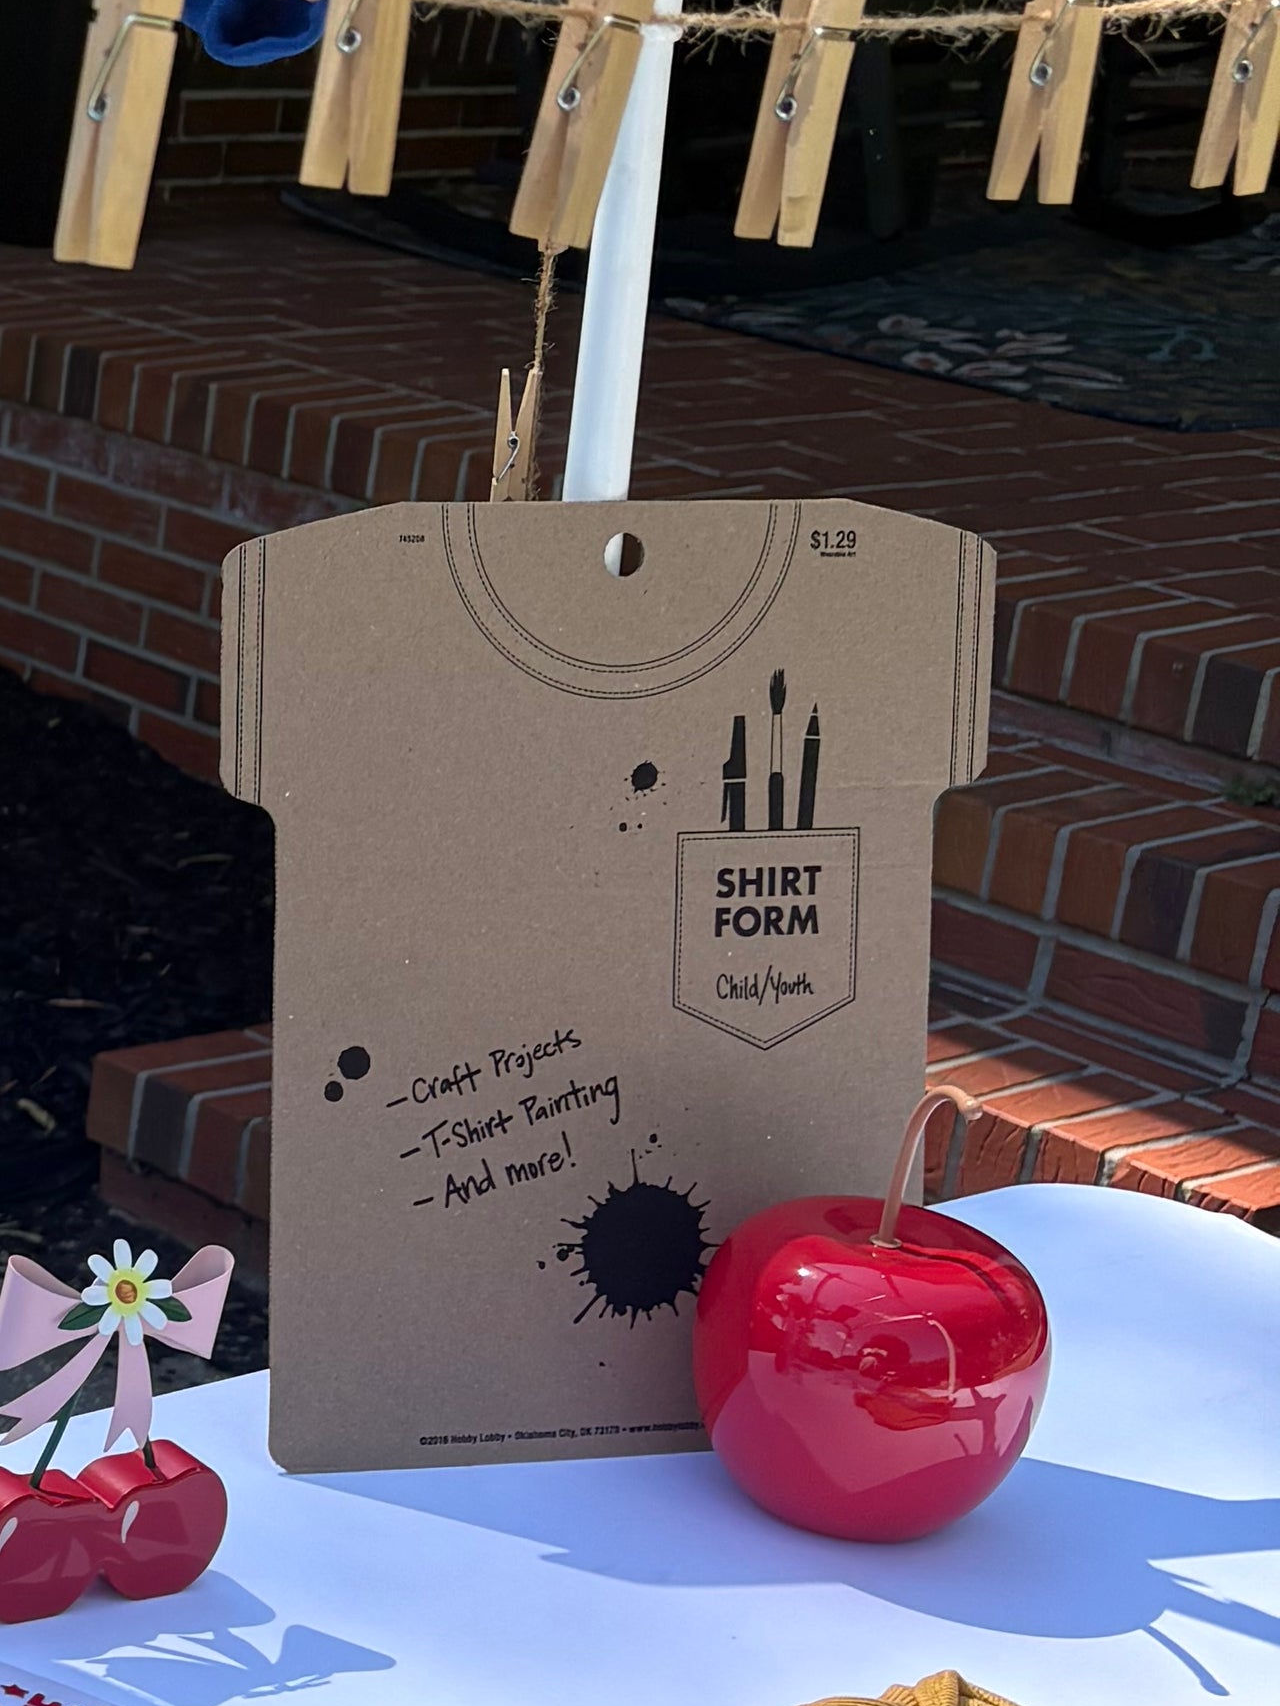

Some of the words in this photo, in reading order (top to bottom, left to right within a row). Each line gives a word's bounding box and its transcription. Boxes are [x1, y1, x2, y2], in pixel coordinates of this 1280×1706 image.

[810, 529, 857, 550] $1.29
[715, 865, 822, 899] SHIRT
[714, 904, 820, 938] FORM
[716, 964, 815, 1006] Child/Youth
[488, 1029, 582, 1079] Projects
[518, 1075, 621, 1126] Painting
[505, 1130, 577, 1186] more!
